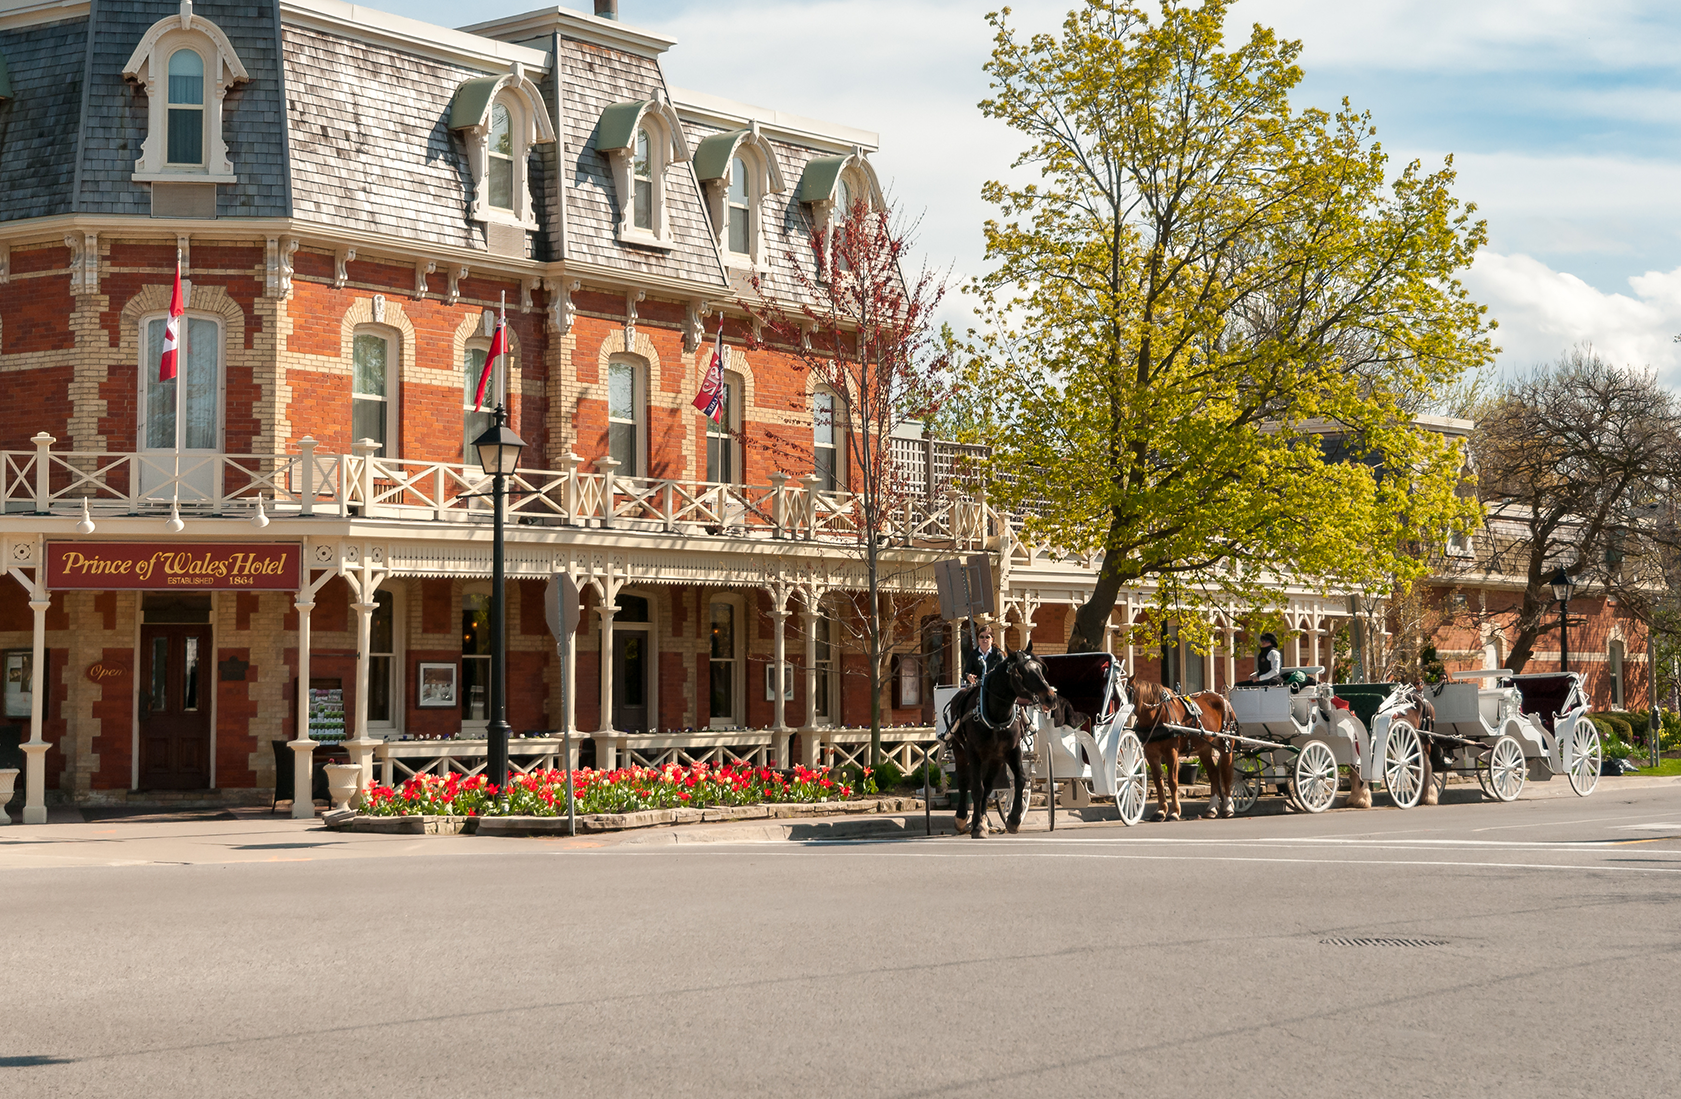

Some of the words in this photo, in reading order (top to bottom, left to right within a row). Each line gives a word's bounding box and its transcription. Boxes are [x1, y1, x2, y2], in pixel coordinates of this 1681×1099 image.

[62, 551, 133, 575] Prince
[136, 551, 162, 580] of
[160, 552, 229, 577] Wales
[228, 553, 287, 575] Hotel
[167, 577, 214, 585] ESTABLISHED
[229, 576, 254, 585] 1864
[90, 664, 123, 681] Open
